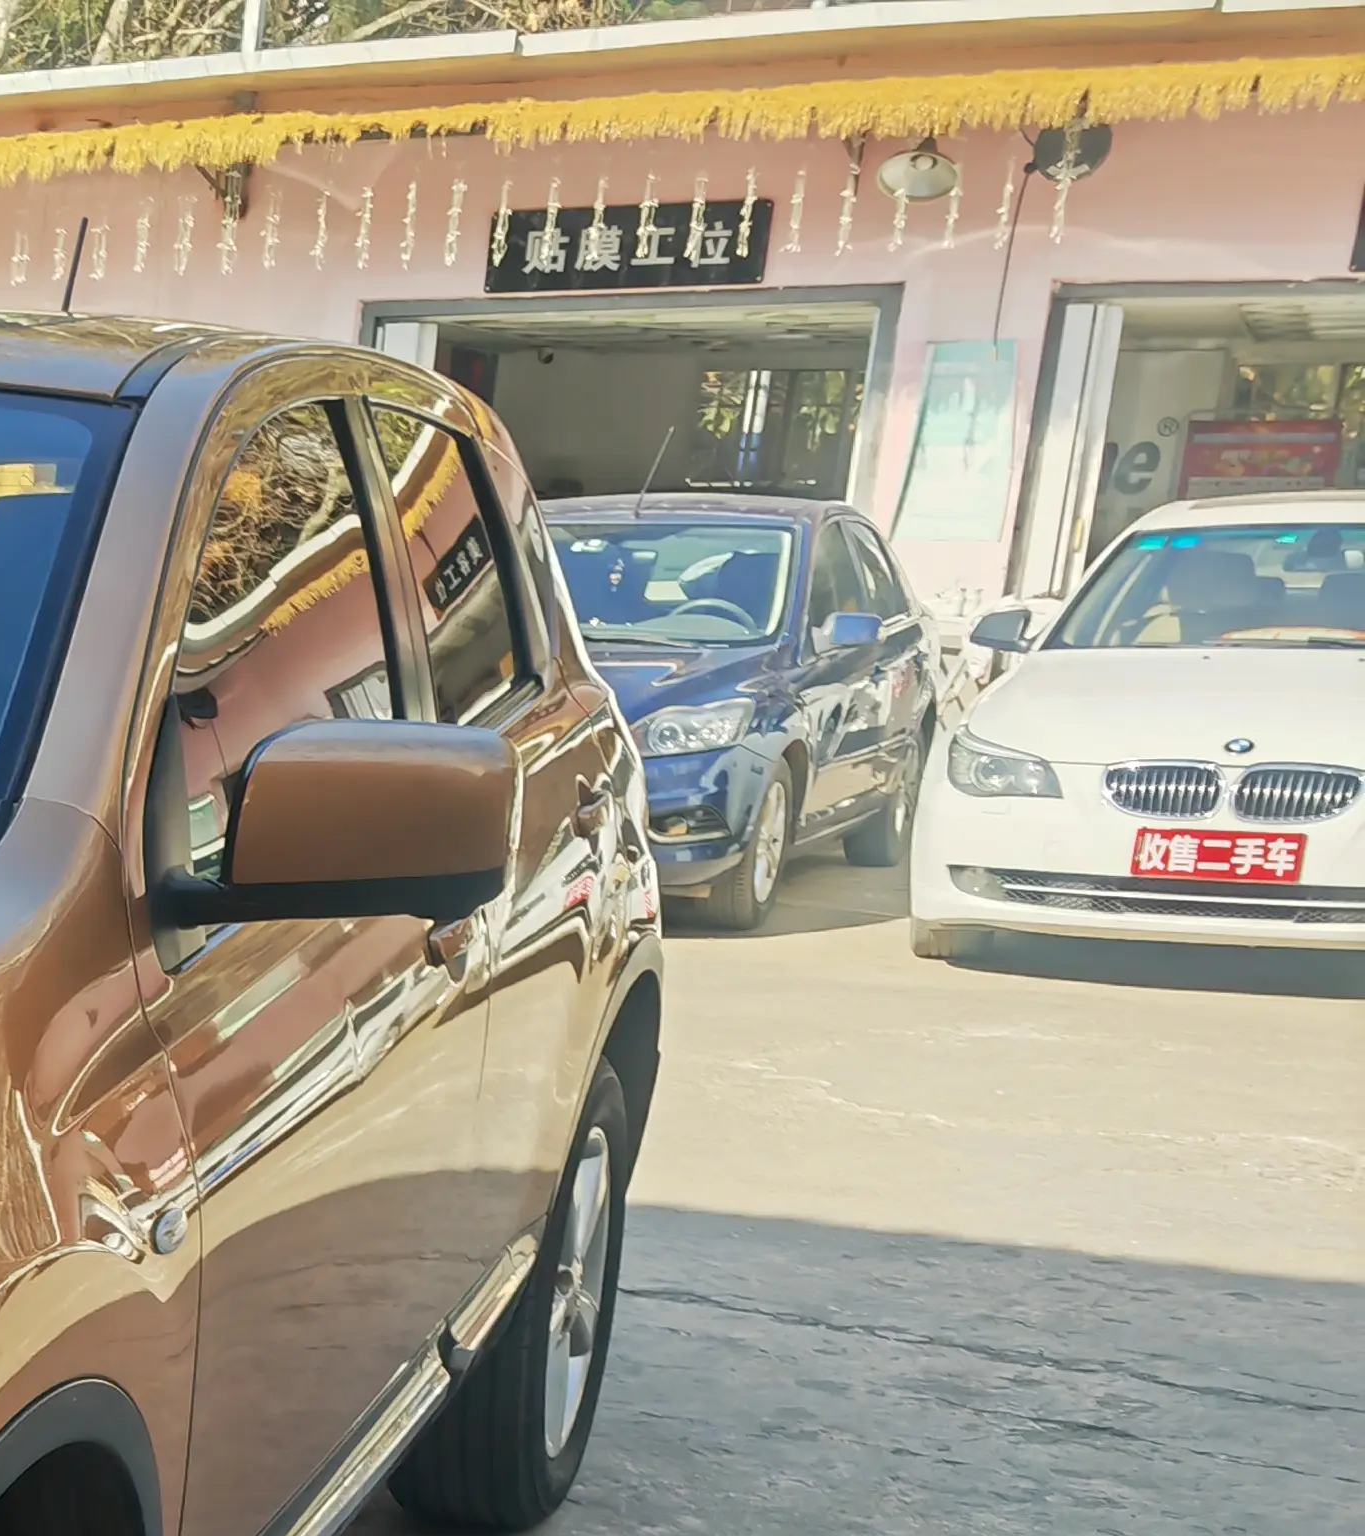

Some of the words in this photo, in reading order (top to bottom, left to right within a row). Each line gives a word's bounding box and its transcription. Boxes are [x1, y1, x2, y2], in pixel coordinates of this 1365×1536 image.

[521, 221, 732, 274] 贴膜工位
[1138, 832, 1299, 877] 收售二手车
